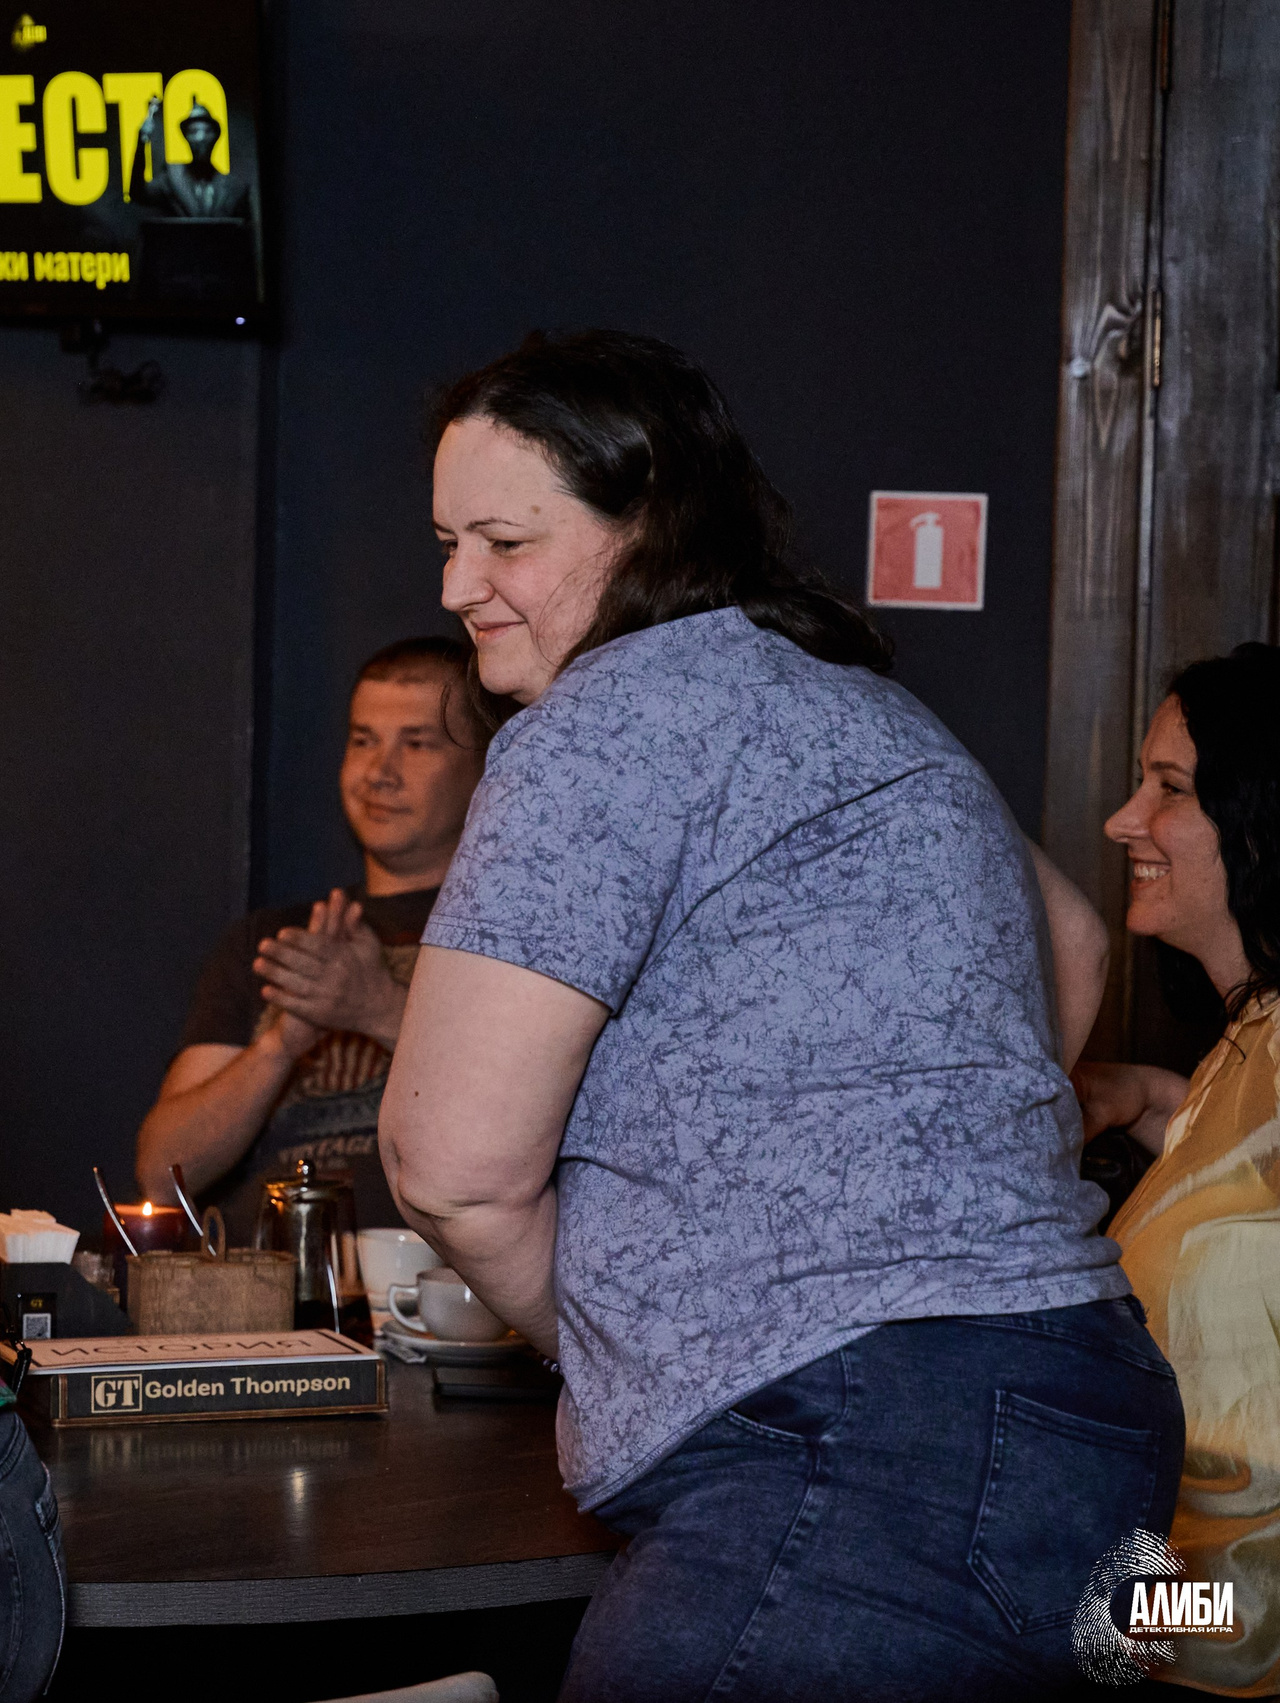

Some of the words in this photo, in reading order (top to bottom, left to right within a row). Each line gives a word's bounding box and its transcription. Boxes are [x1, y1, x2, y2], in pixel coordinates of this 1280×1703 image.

[33, 251, 130, 290] матери
[94, 1379, 140, 1408] GT
[144, 1378, 225, 1399] Golden
[230, 1375, 351, 1397] Thompson
